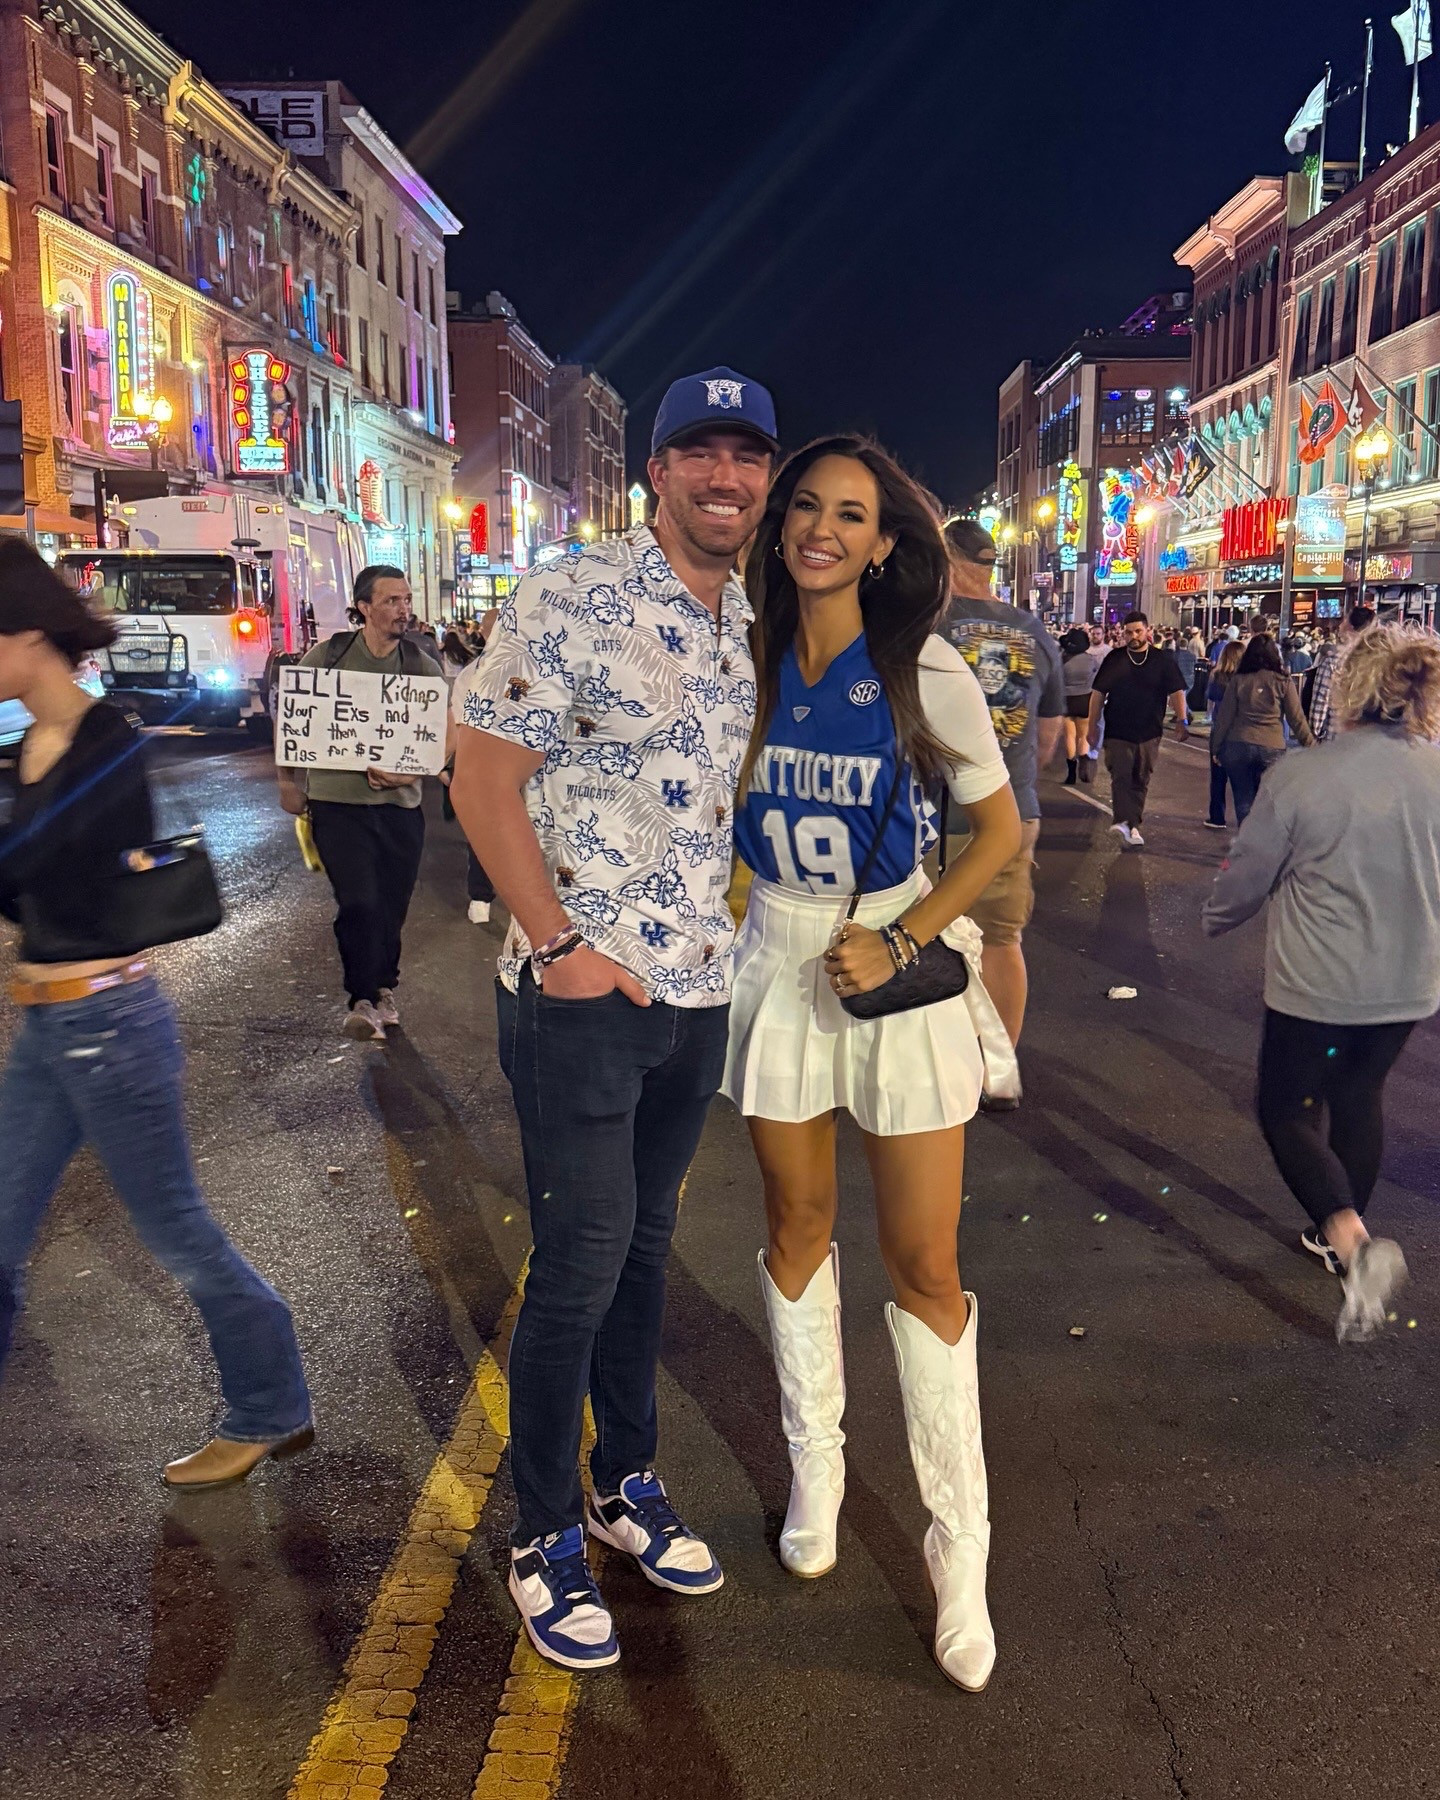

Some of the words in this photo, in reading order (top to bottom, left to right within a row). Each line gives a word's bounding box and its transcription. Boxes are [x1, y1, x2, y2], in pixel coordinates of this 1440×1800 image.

[114, 283, 131, 410] MIRANDA
[248, 354, 269, 445] WHISKEY
[539, 587, 590, 624] WILDCAT
[593, 639, 622, 652] CATS
[852, 683, 878, 703] SEC
[284, 697, 318, 719] Your
[334, 701, 370, 722] Exs
[327, 723, 358, 740] them
[375, 724, 394, 740] to
[413, 724, 438, 743] the
[355, 742, 385, 762] $5
[748, 745, 882, 807] NTUCKY
[566, 784, 617, 800] WILDCATS
[661, 778, 692, 808] UK
[761, 809, 856, 896] 19
[639, 921, 671, 948] UK
